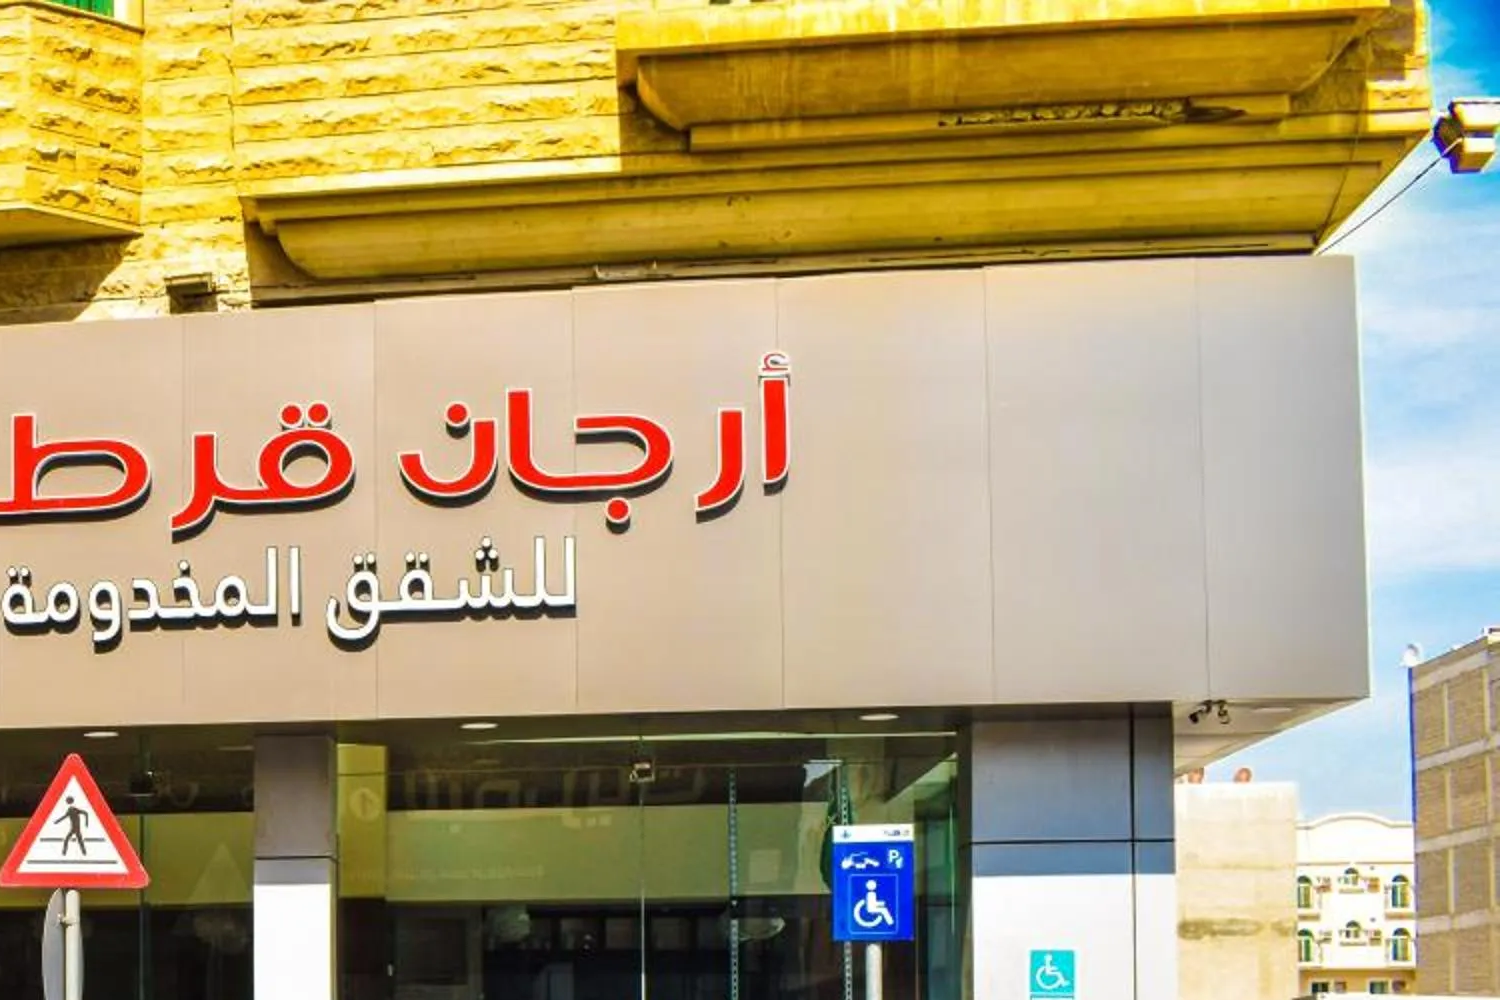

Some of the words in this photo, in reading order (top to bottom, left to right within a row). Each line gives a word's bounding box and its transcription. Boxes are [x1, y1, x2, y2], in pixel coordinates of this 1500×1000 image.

[398, 351, 790, 526] أرجان
[0, 546, 302, 645] المخدومة
[326, 536, 576, 642] للشقق
